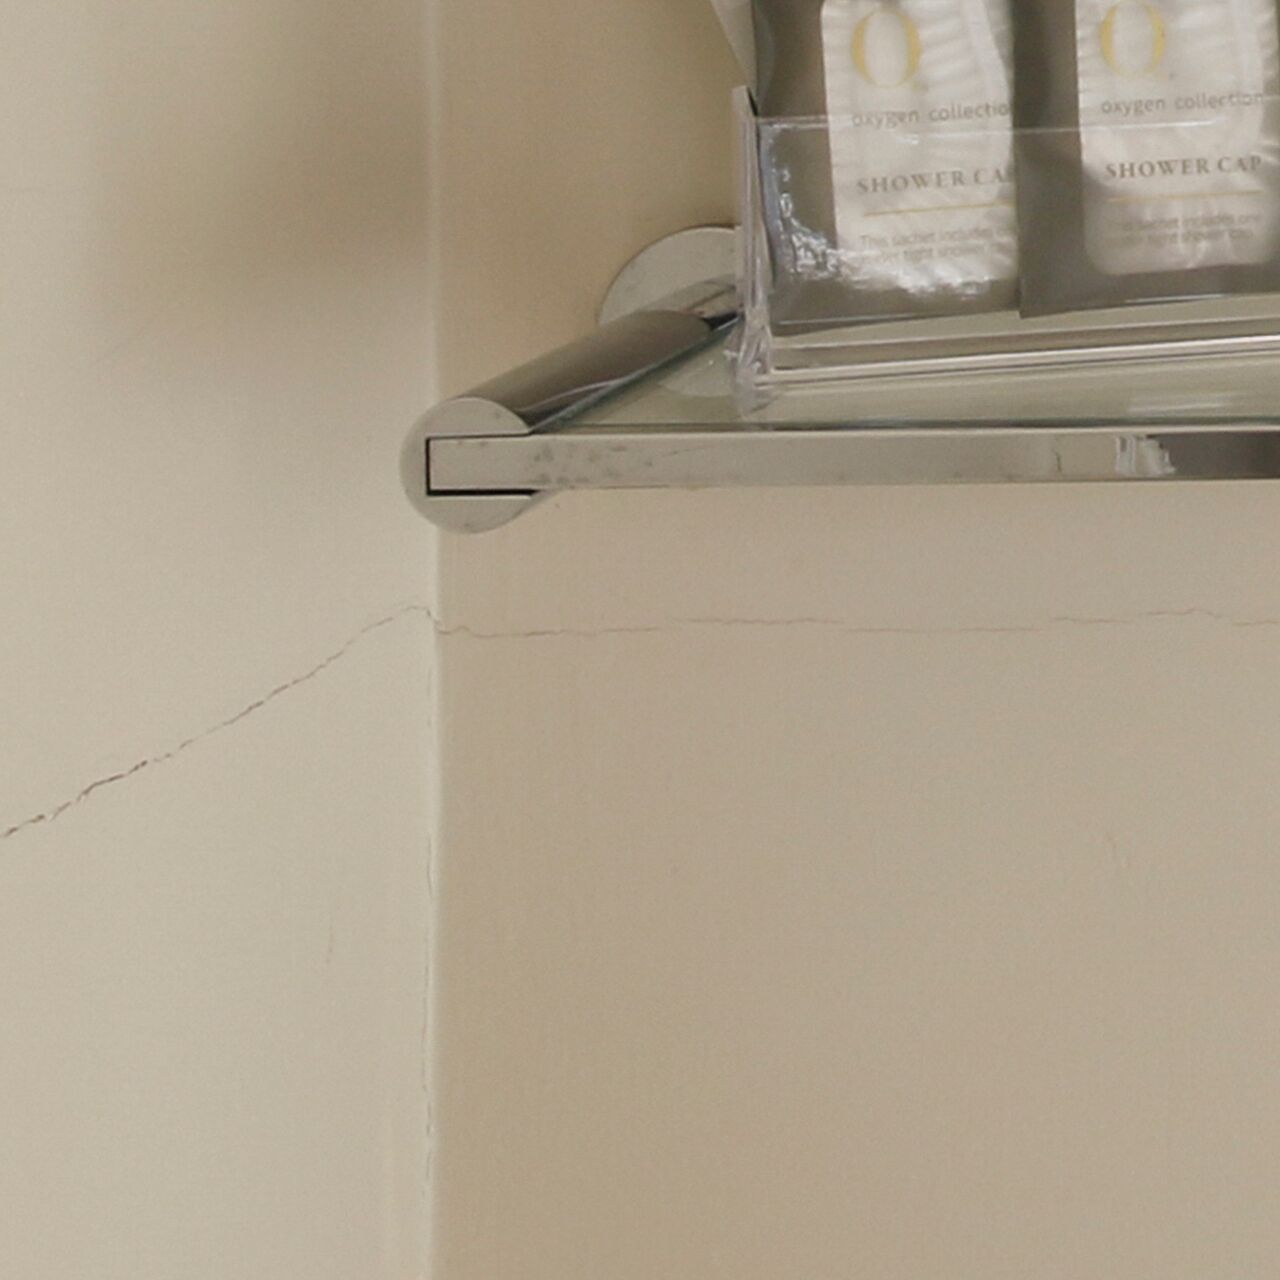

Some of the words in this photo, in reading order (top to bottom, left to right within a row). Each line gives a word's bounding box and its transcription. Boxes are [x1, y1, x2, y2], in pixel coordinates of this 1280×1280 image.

[852, 110, 919, 131] oxygen
[929, 101, 1010, 122] collectio
[1101, 98, 1166, 118] oxygen
[1174, 91, 1264, 111] collection
[1105, 158, 1210, 179] SHOWER
[1216, 154, 1263, 173] CAP
[856, 170, 966, 195] SHOWER
[972, 167, 1010, 186] CA
